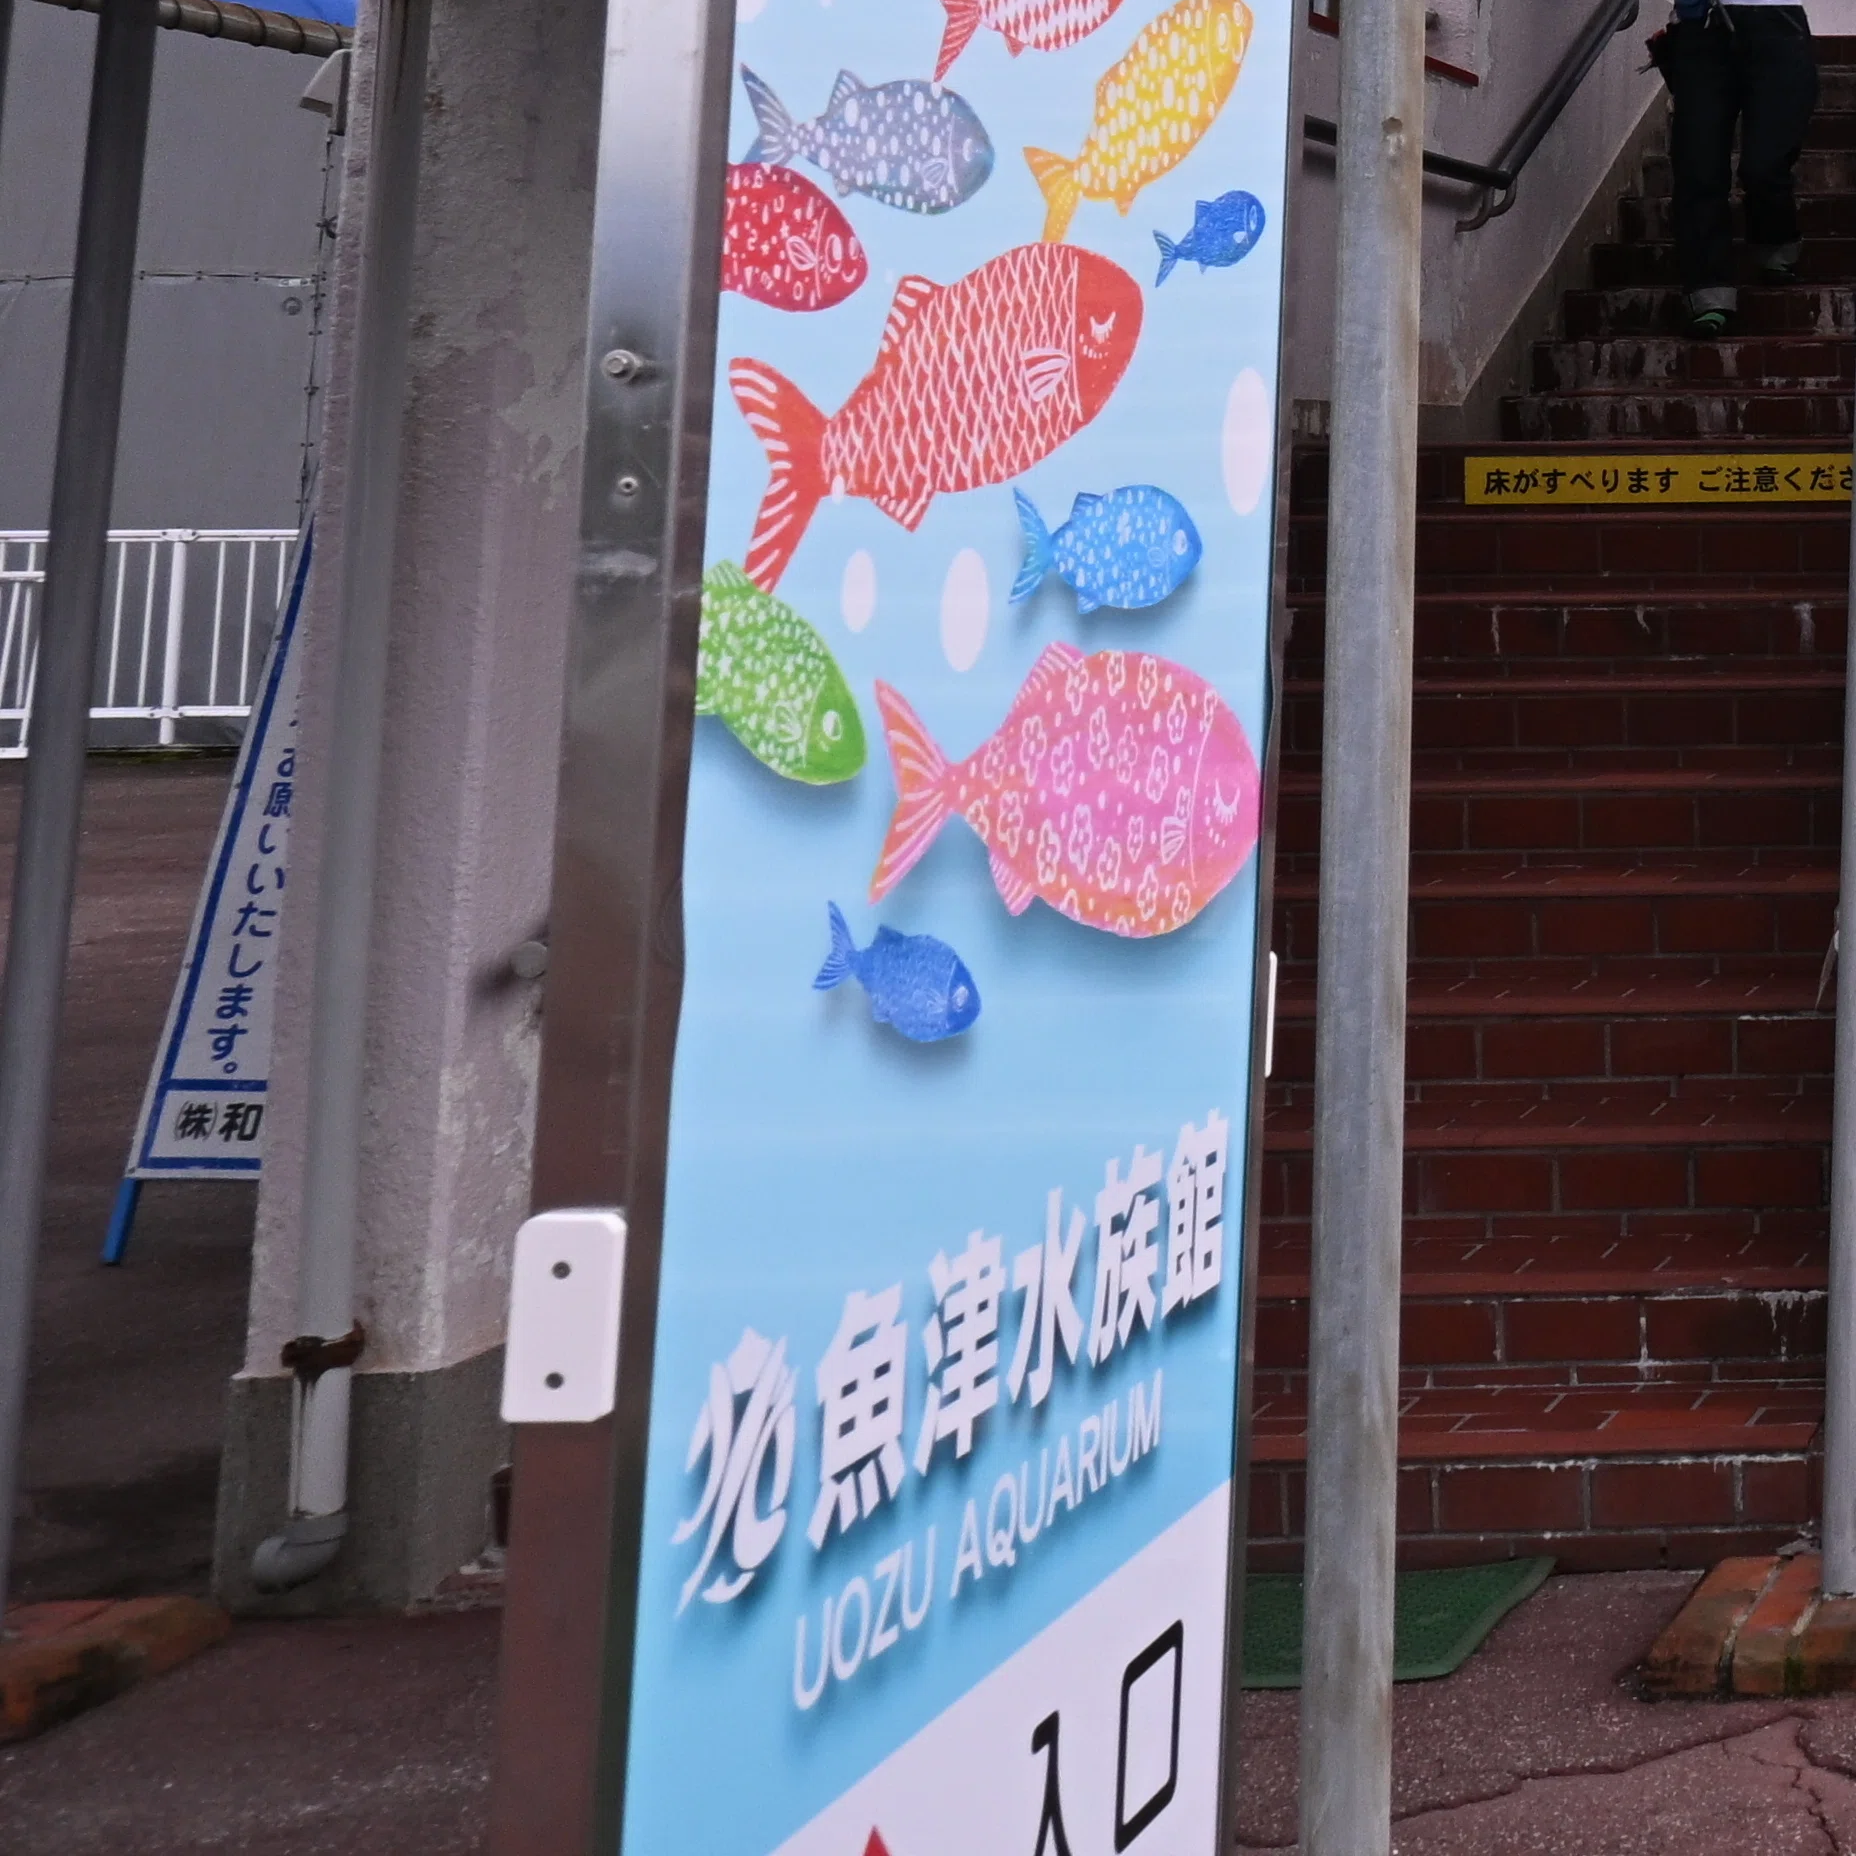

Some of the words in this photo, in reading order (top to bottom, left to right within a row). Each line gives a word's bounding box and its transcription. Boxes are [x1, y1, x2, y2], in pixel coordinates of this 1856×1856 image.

[1483, 467, 1680, 496] 床がすべります
[805, 1107, 1230, 1552] 魚津水族館
[791, 1524, 937, 1712] UOZU
[950, 1369, 1164, 1600] AQUARIUM
[1030, 1618, 1184, 1856] 入口
